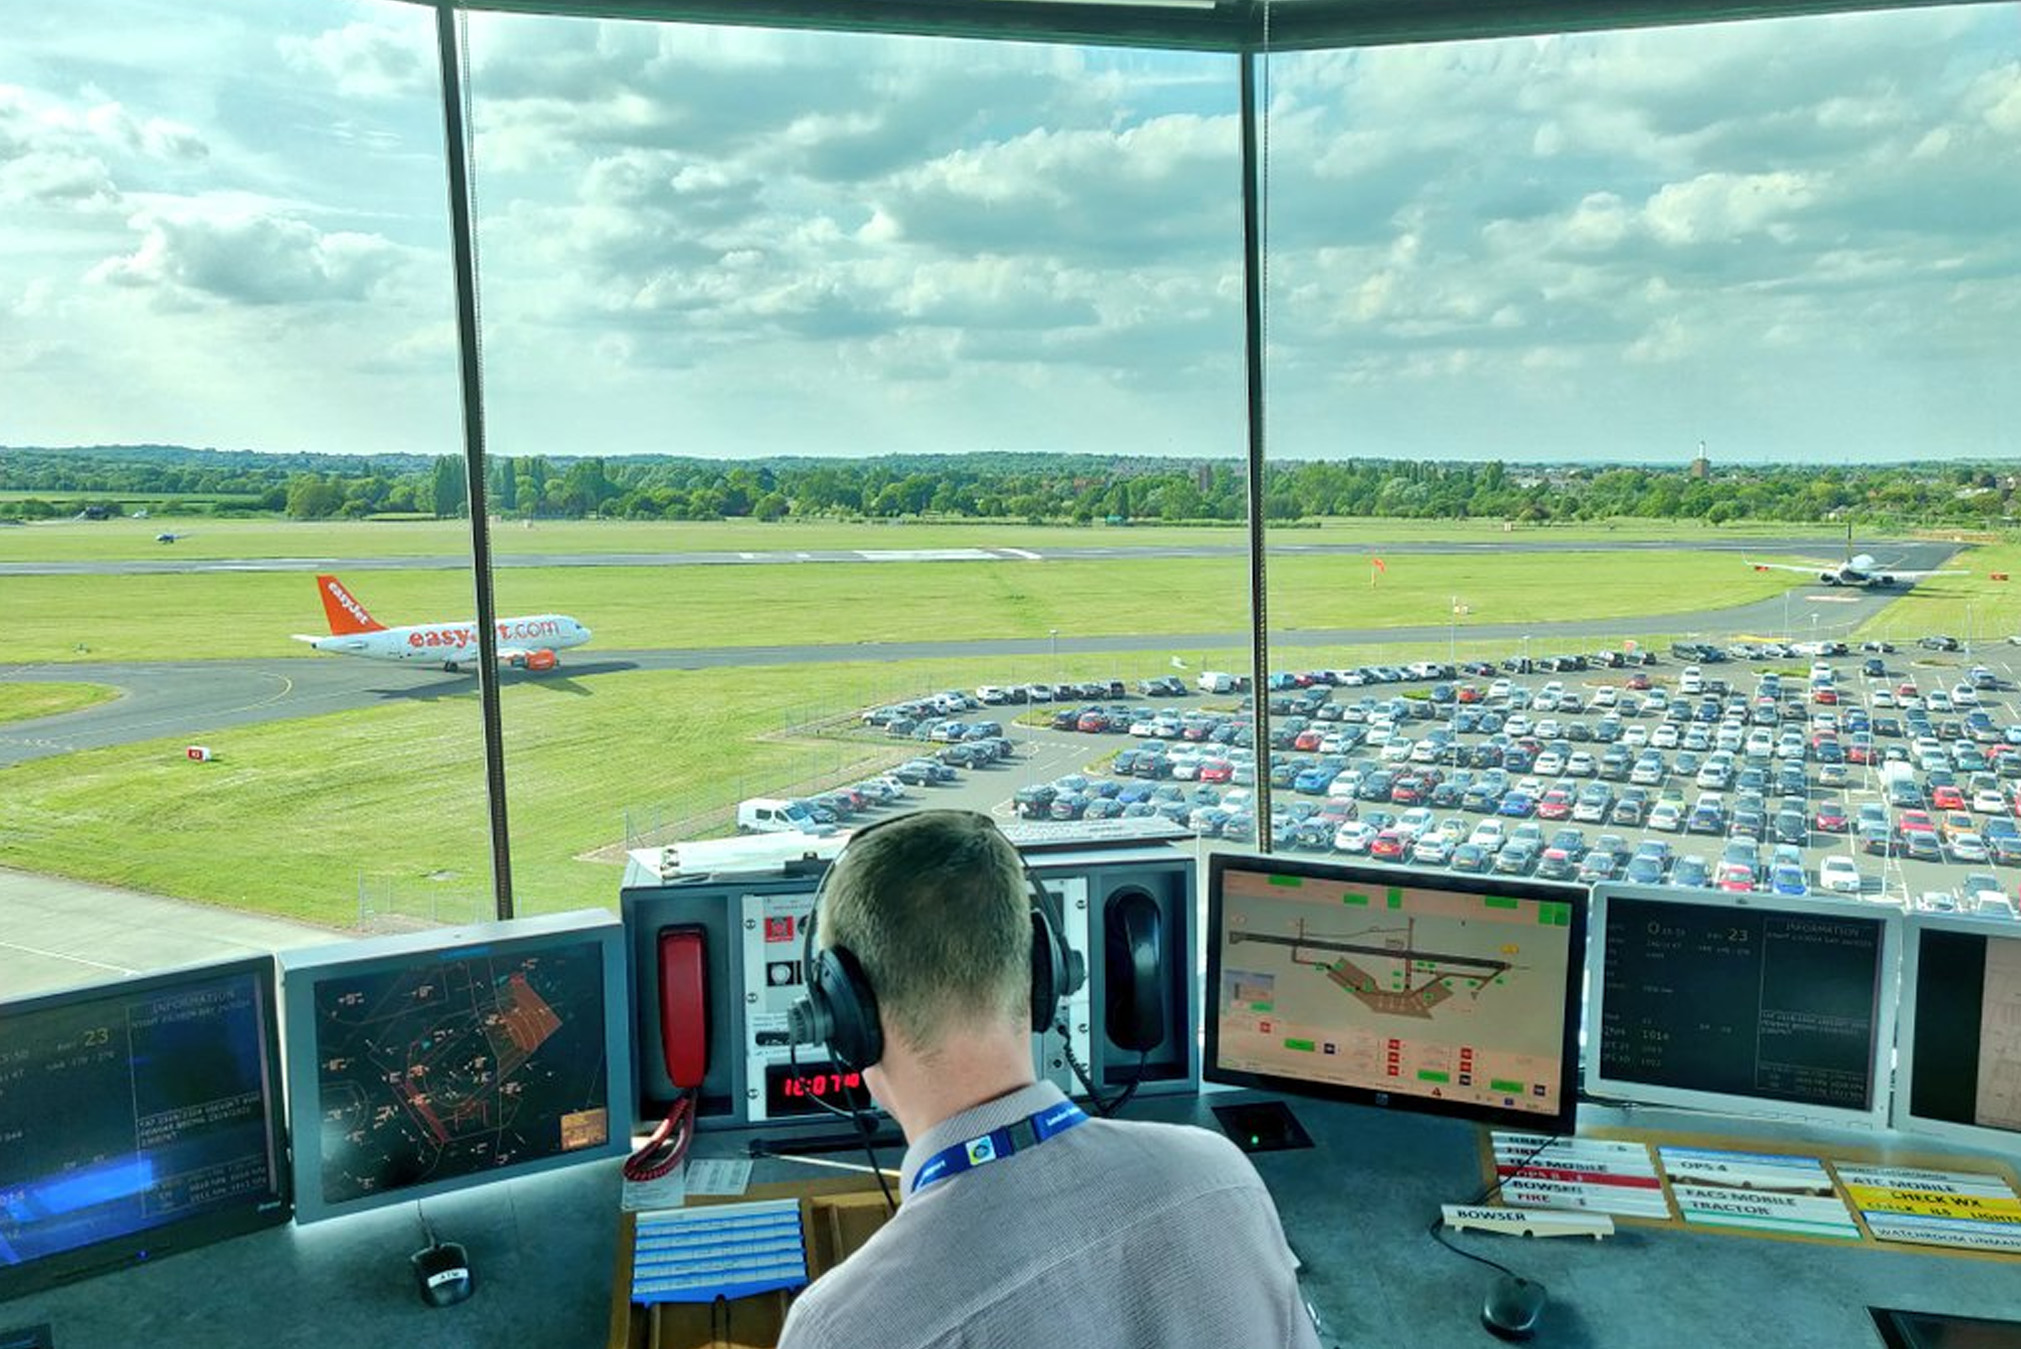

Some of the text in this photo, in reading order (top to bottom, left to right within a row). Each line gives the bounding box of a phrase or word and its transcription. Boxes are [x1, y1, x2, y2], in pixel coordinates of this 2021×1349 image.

[409, 620, 560, 648] easyt.com
[1728, 928, 1749, 941] 23
[84, 1027, 109, 1047] 23
[1681, 1160, 1728, 1172] OPS 4
[1853, 1177, 1959, 1193] ATC MOBILE
[1516, 1193, 1550, 1203] FIRE
[1731, 1193, 1798, 1207] MOBILE
[1891, 1191, 1983, 1208] CHECK WX
[1691, 1201, 1771, 1216] TRACTOR
[1457, 1210, 1527, 1222] BOWSER
